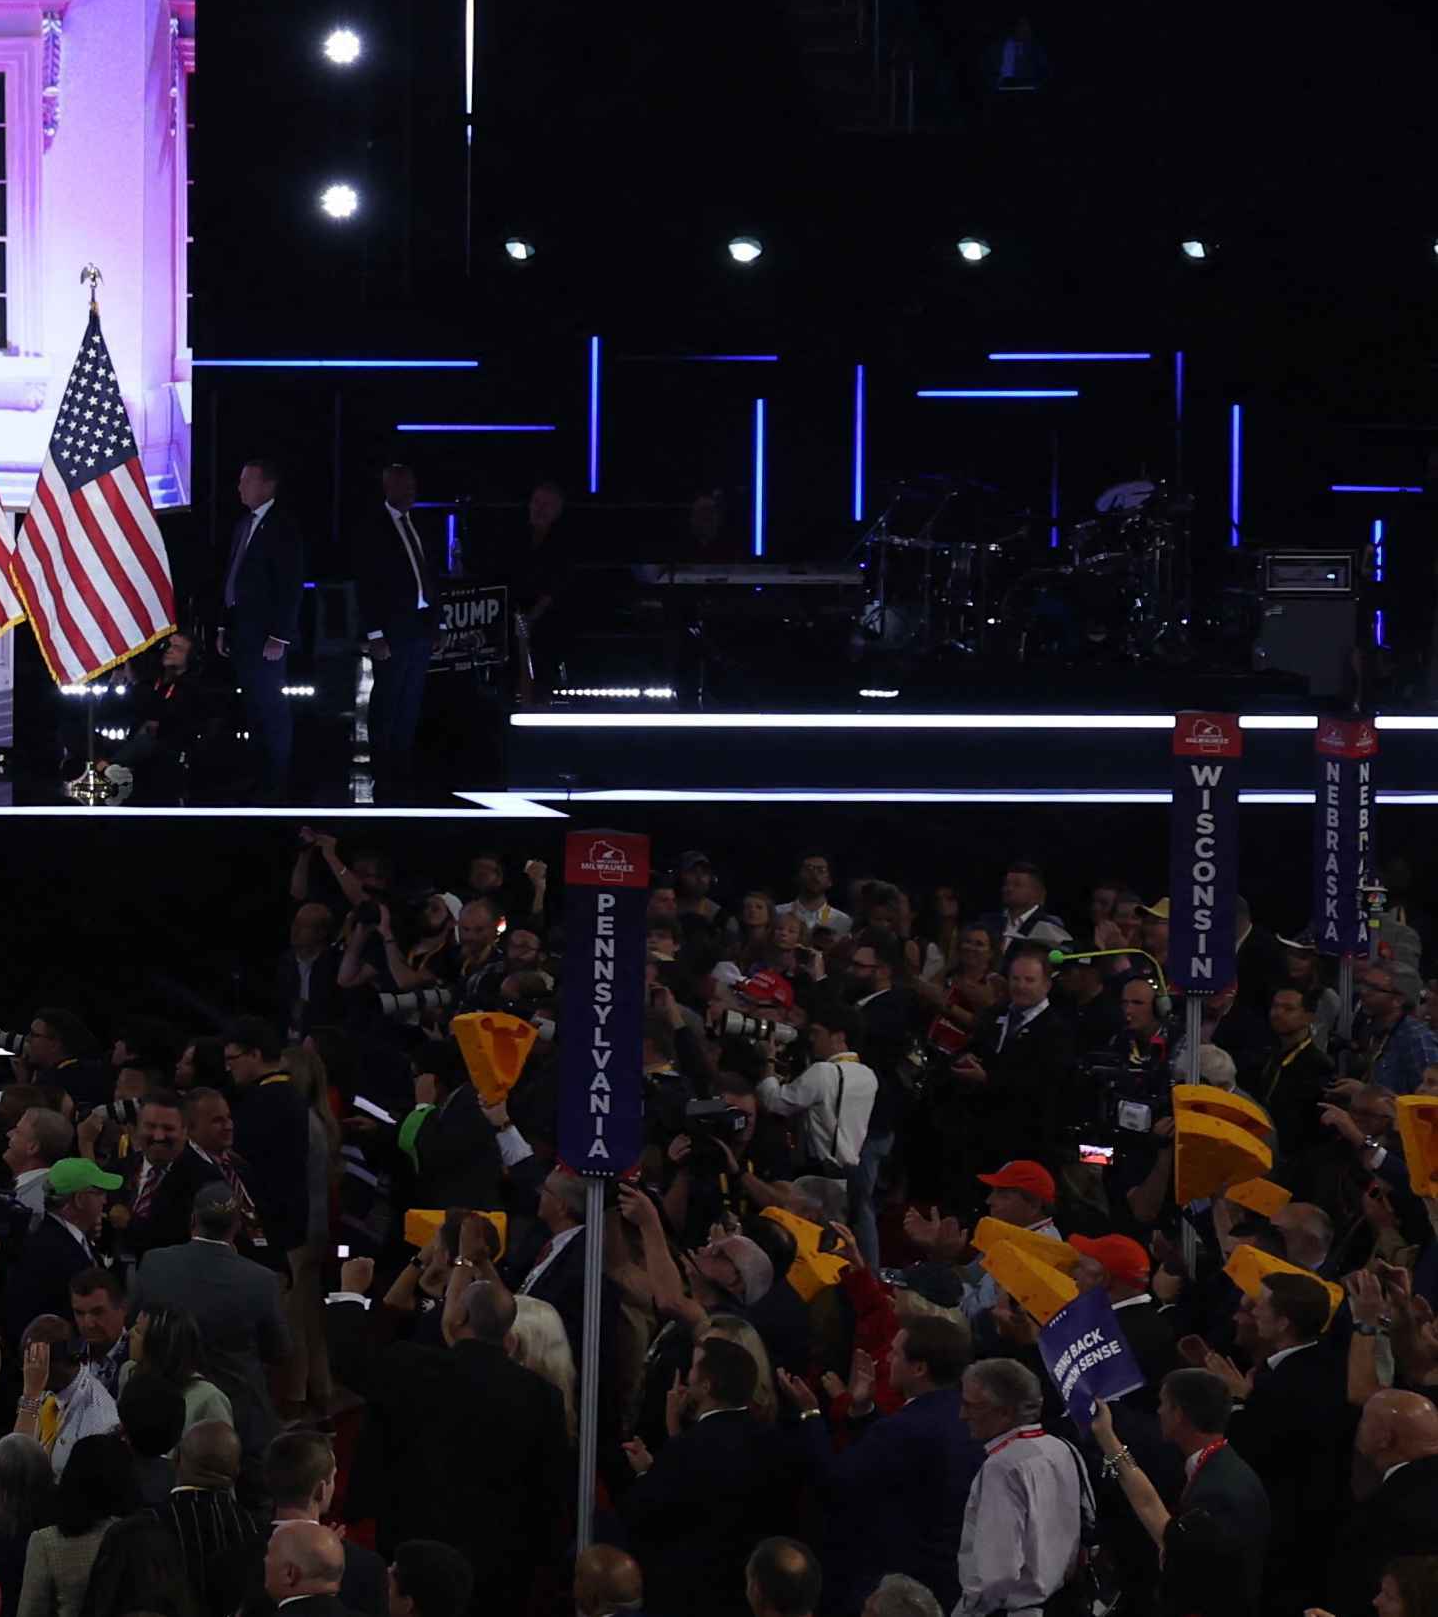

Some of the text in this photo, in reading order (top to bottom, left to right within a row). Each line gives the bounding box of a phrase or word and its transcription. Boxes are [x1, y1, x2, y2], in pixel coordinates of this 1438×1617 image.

[441, 598, 500, 630] RUMP
[1190, 764, 1224, 979] WISCONSIN
[1325, 761, 1341, 942] NEBRASKA
[587, 893, 616, 1159] PENNSYLVANIA
[1069, 1327, 1105, 1359] BACK
[1078, 1340, 1123, 1372] SENSE
